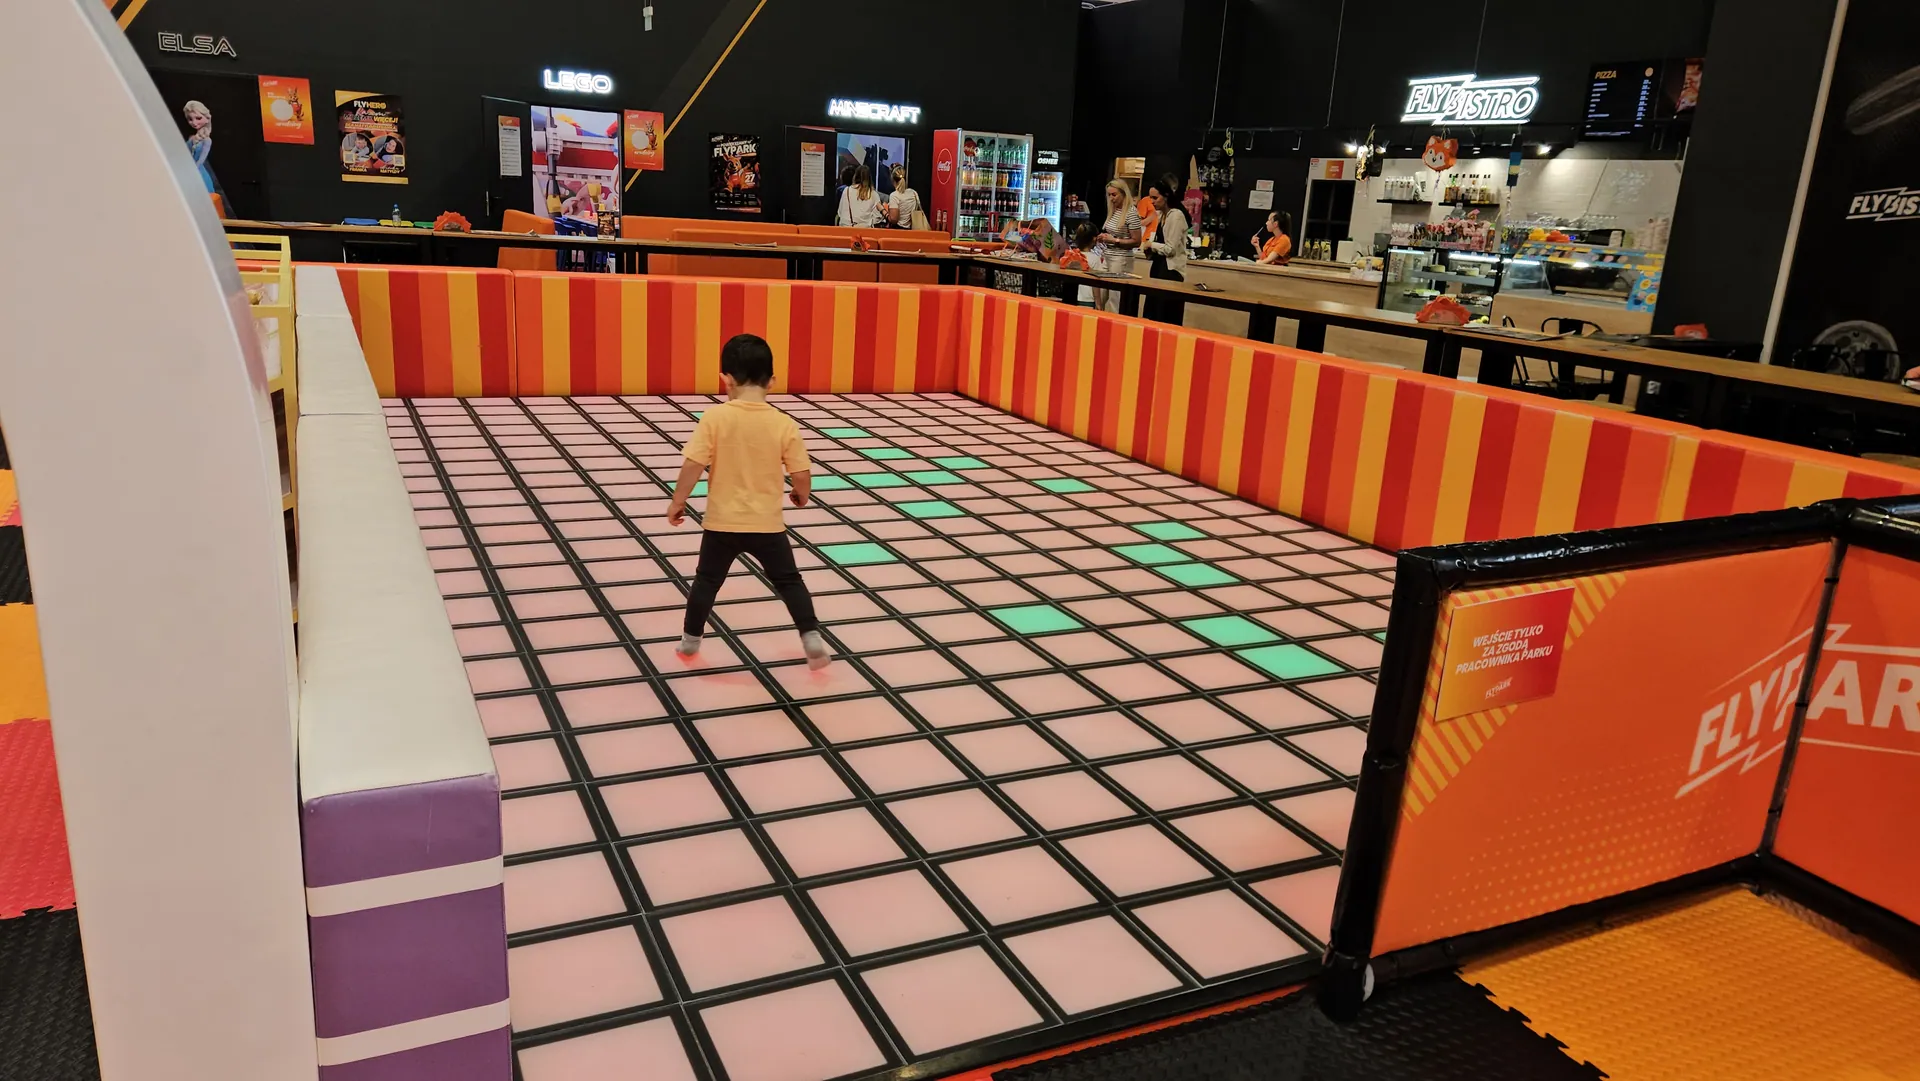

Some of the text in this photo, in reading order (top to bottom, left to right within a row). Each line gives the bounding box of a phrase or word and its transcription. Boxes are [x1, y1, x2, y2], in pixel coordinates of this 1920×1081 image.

[158, 32, 237, 57] ELSA
[543, 68, 613, 94] LEGO
[1594, 70, 1617, 79] PIZZA
[827, 98, 921, 124] MINECRAFT
[713, 143, 757, 157] FLYPARK
[744, 173, 756, 183] 27
[1849, 193, 1920, 216] FLYBIS
[1473, 624, 1543, 648] WEJŚCIE TYLKO
[1455, 645, 1553, 675] PRACOWNIKA PARKU
[1482, 645, 1495, 657] ZA
